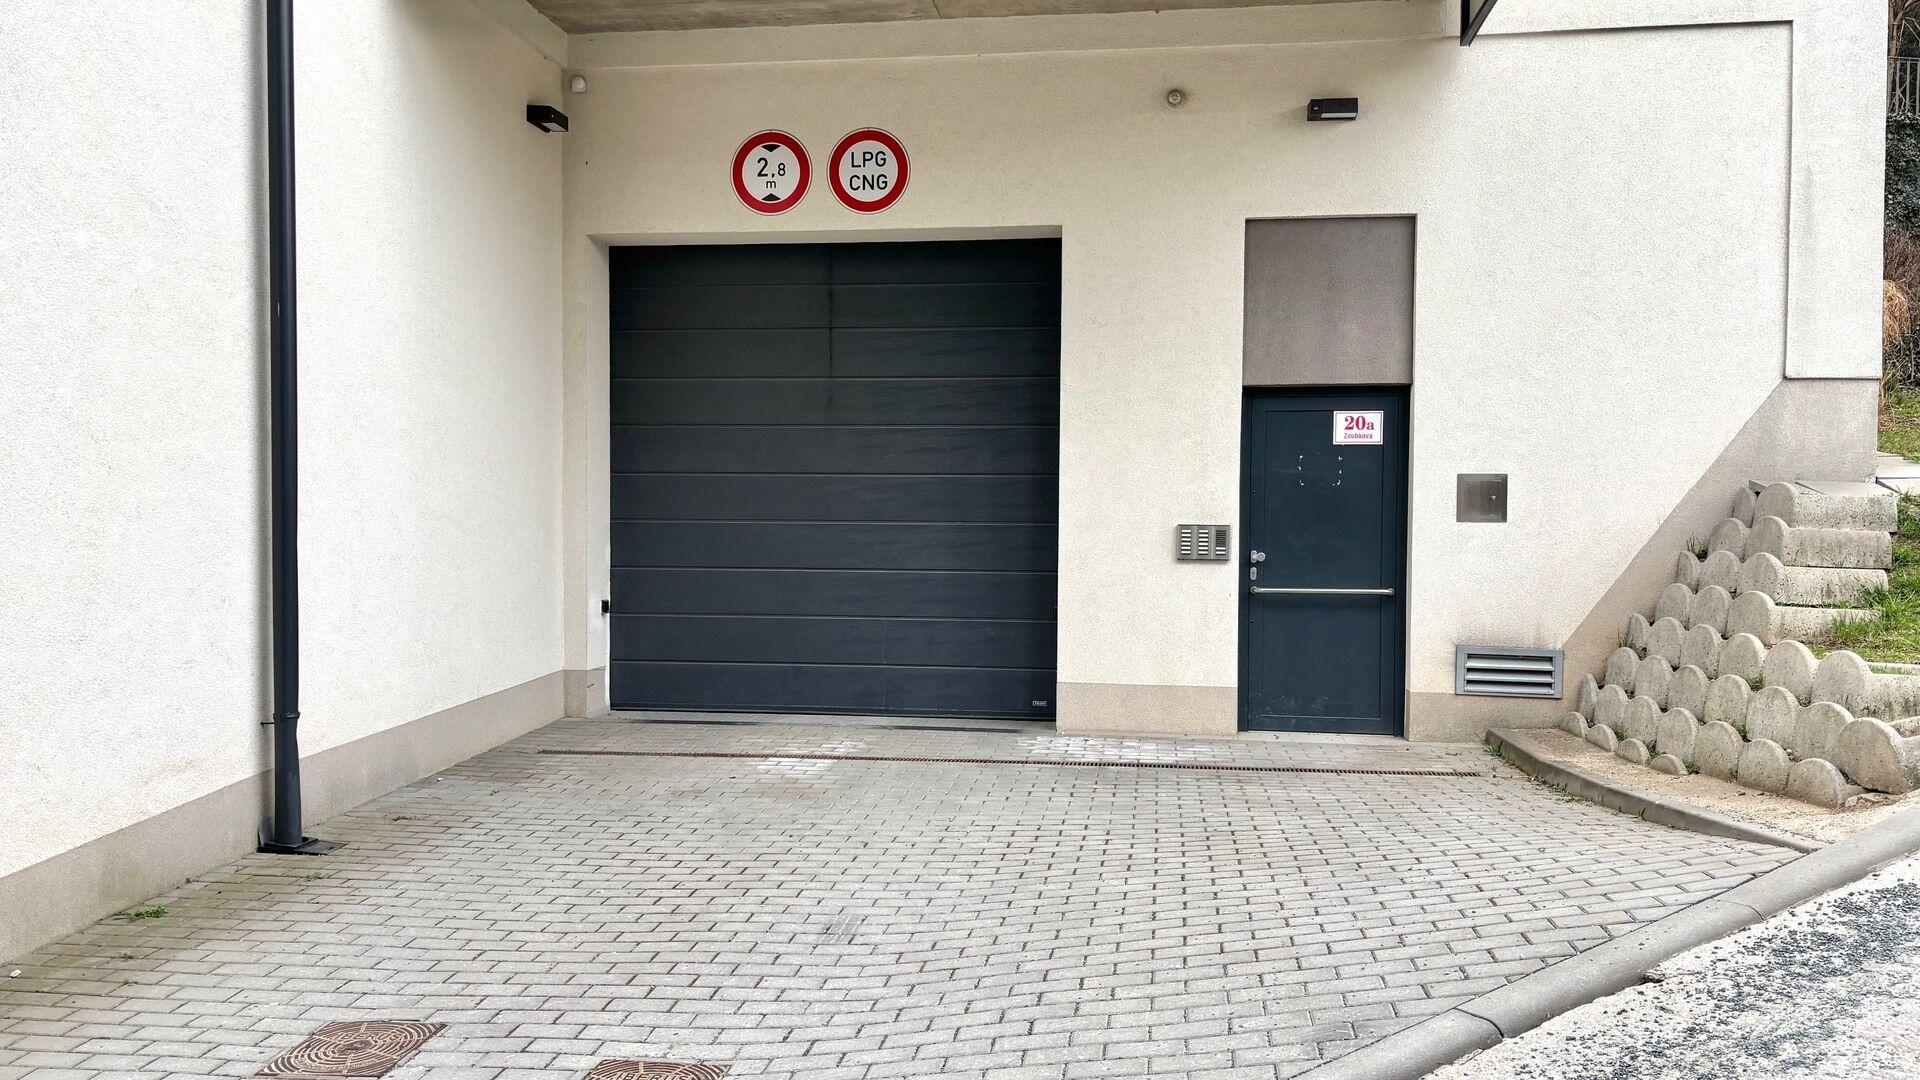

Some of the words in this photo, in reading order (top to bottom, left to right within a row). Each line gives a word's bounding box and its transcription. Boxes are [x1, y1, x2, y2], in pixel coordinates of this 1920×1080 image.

[757, 157, 786, 178] 2,8
[851, 151, 887, 168] LPG
[766, 180, 776, 189] m
[849, 174, 888, 191] CNG
[1344, 415, 1375, 431] 20a
